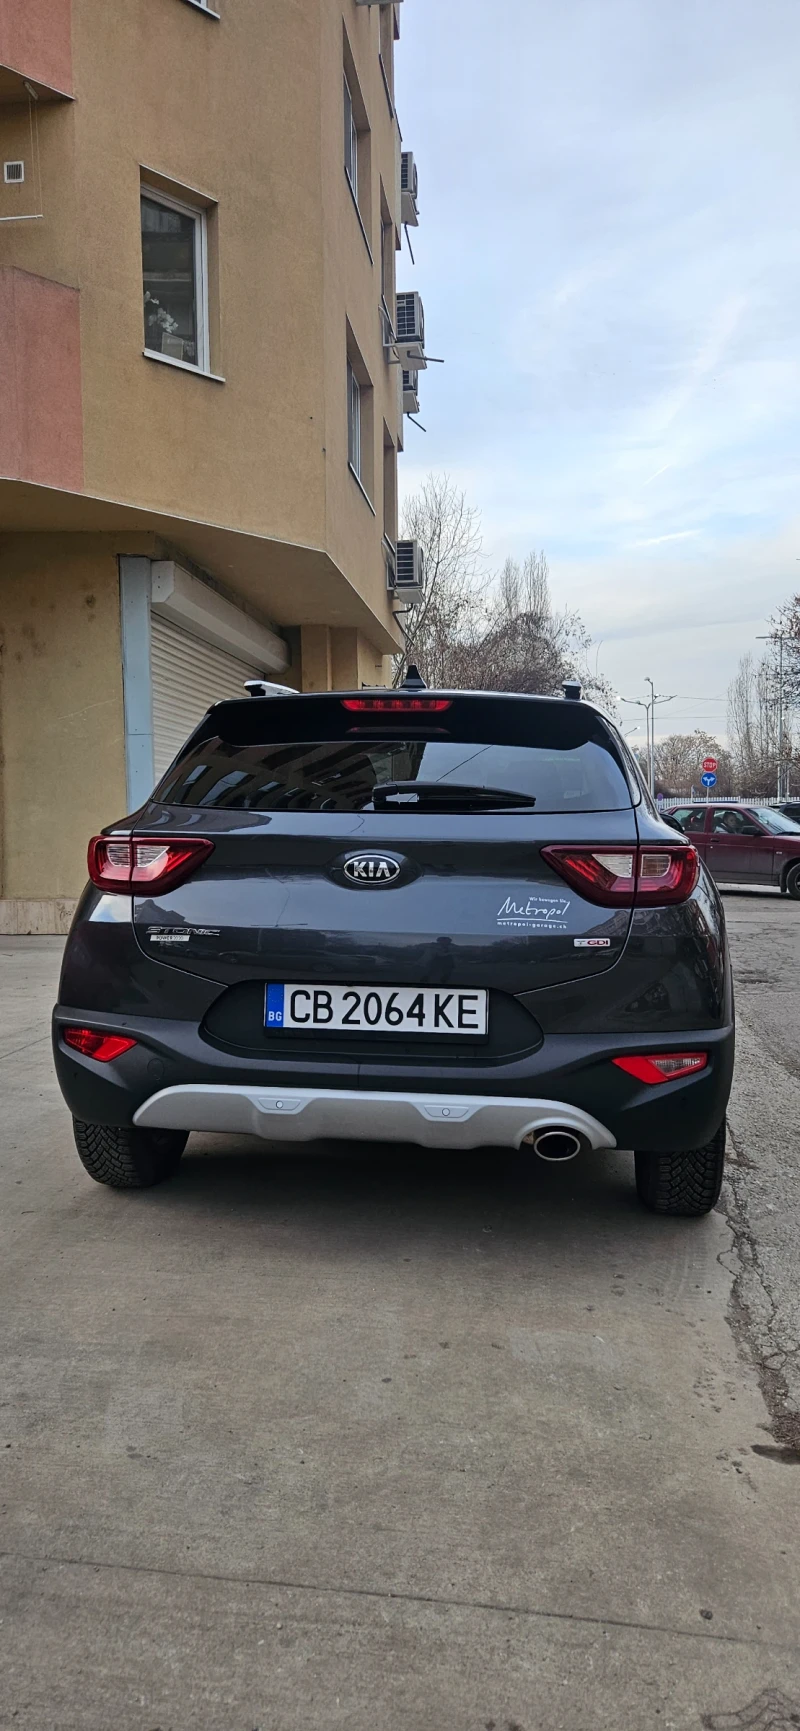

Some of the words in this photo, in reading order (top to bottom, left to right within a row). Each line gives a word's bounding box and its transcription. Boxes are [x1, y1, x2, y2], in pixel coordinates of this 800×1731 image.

[353, 861, 391, 877] KIA
[497, 896, 571, 920] Metropol
[145, 925, 221, 936] STONIC
[497, 921, 567, 929] metropol-garage.ch
[290, 989, 334, 1024] CB
[341, 991, 426, 1027] 2064
[434, 993, 479, 1029] KE
[268, 1011, 282, 1021] BG
